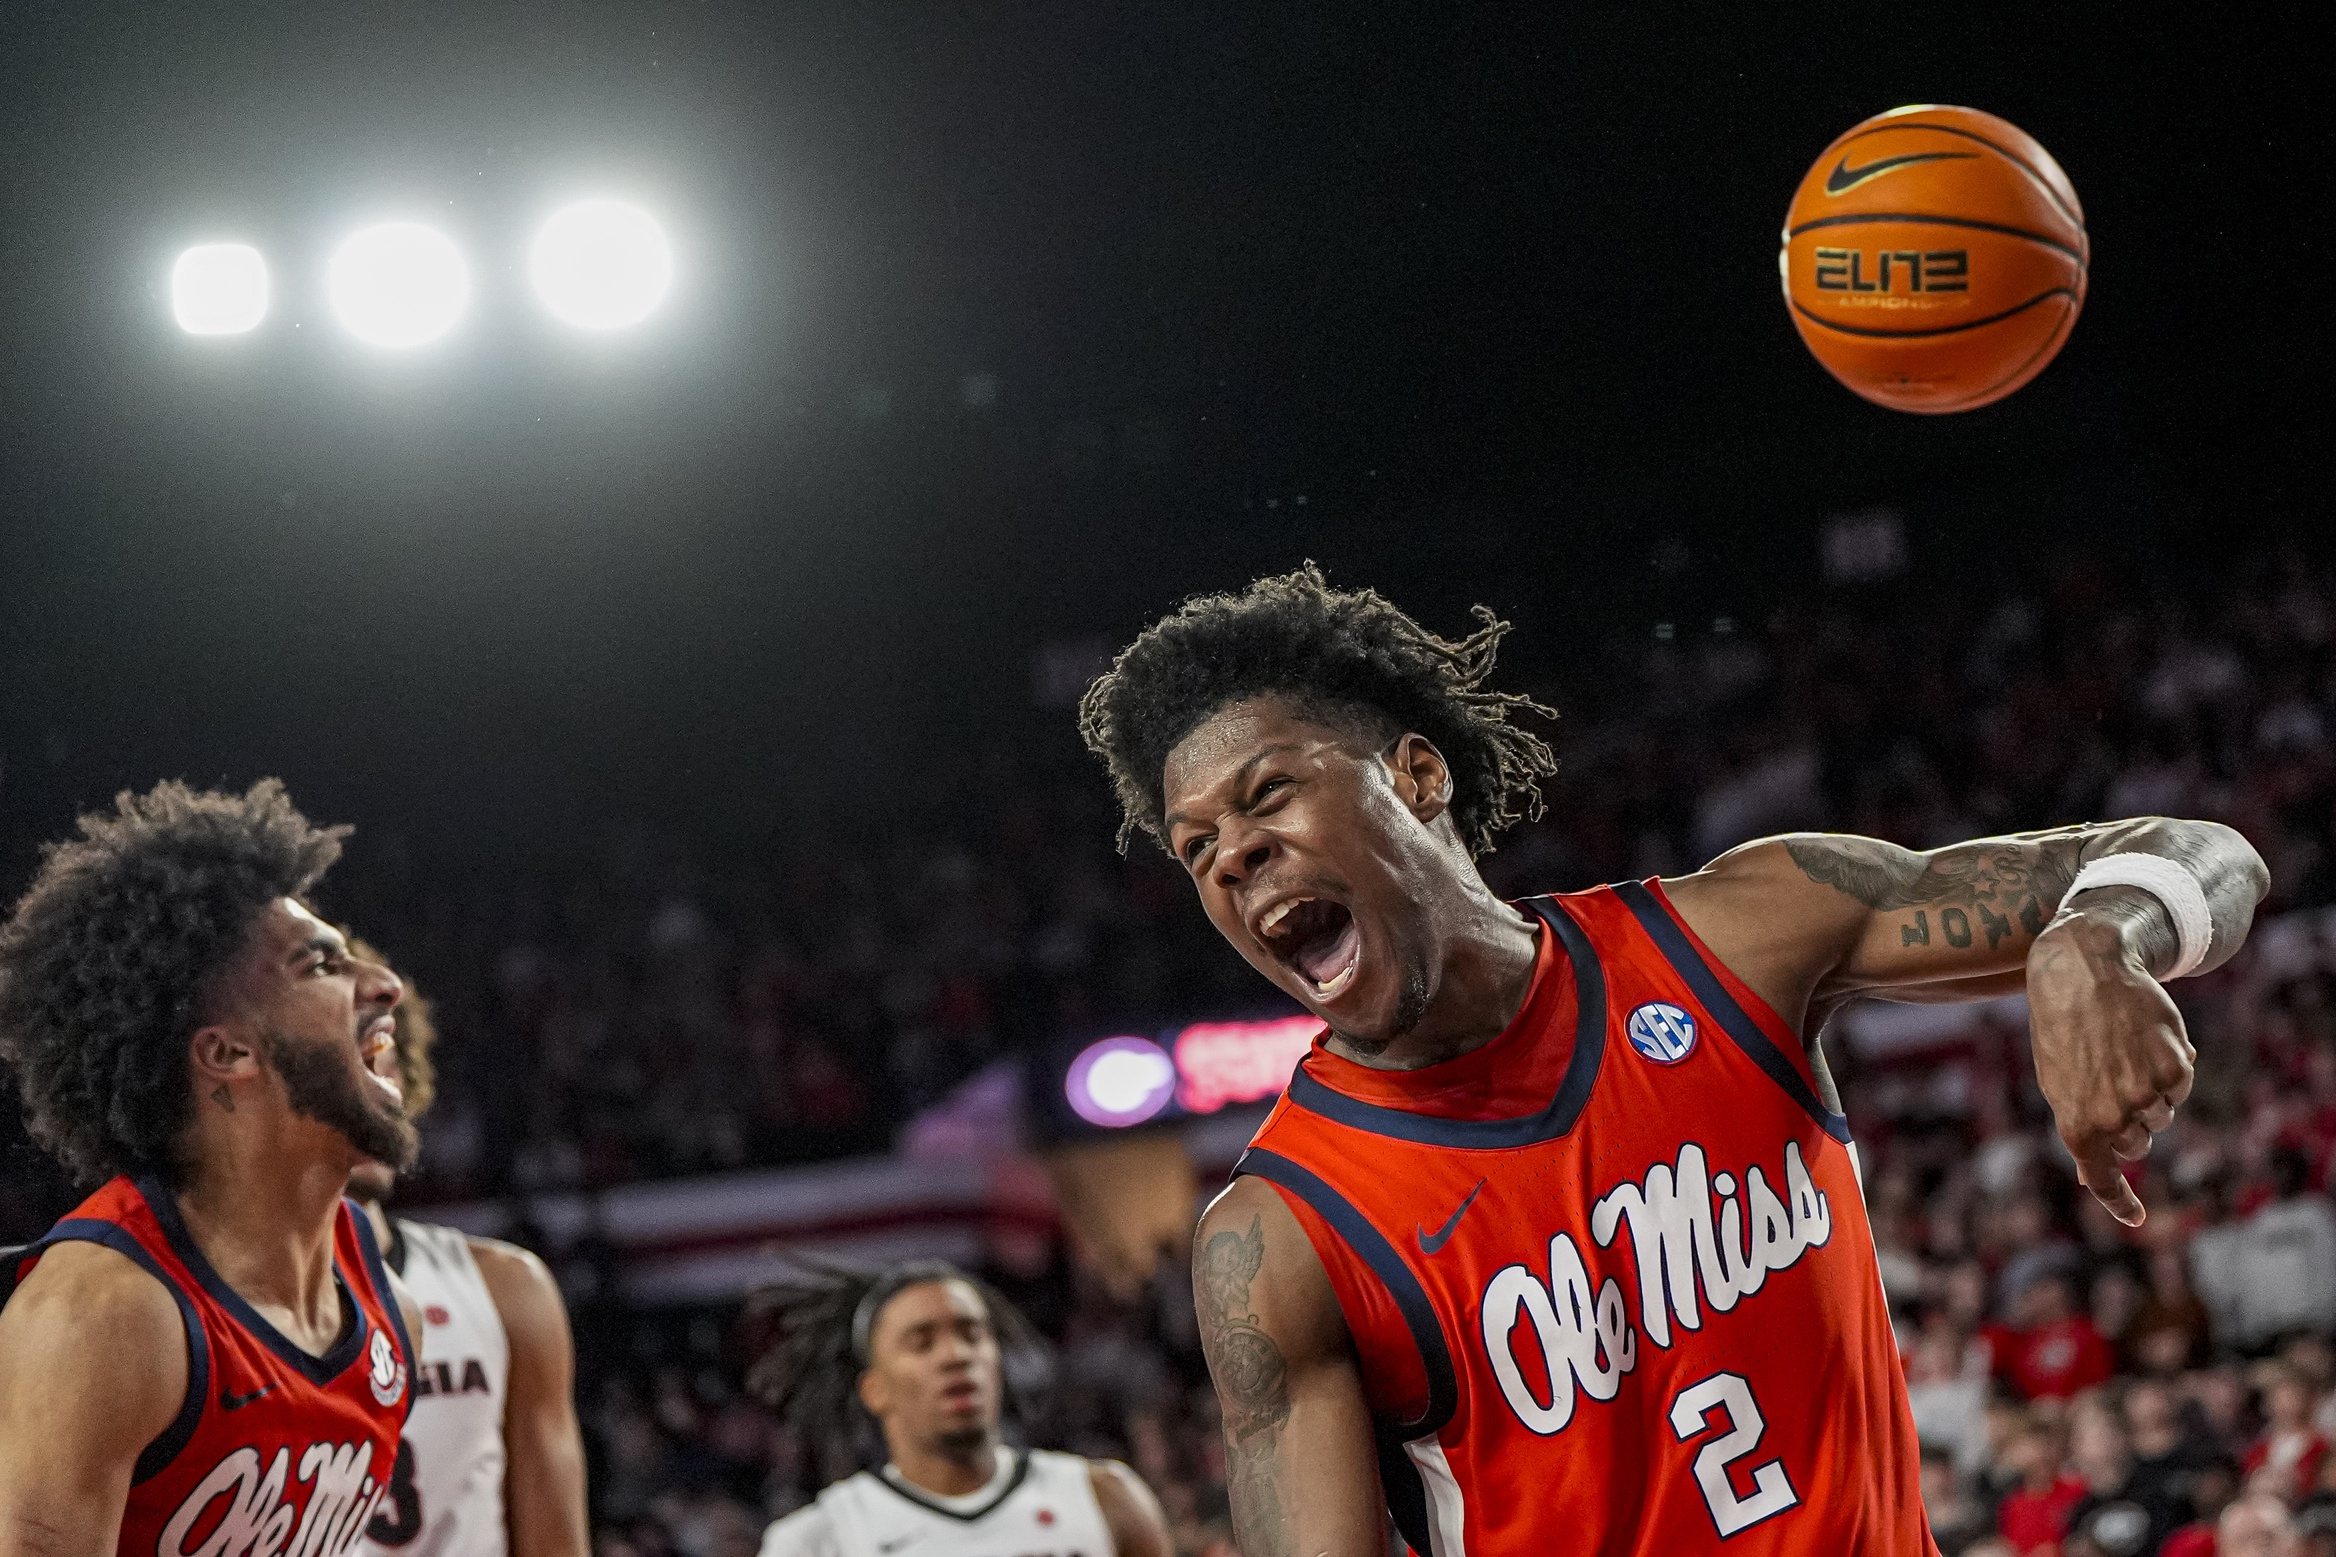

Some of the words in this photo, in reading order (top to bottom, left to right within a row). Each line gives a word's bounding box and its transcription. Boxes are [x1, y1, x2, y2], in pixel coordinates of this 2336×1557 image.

[1815, 246, 1969, 293] ELITE
[1629, 1003, 1694, 1061] SEC
[1481, 1231, 1636, 1436] Ole
[1591, 1140, 1832, 1349] Miss
[1667, 1369, 1802, 1543] 2
